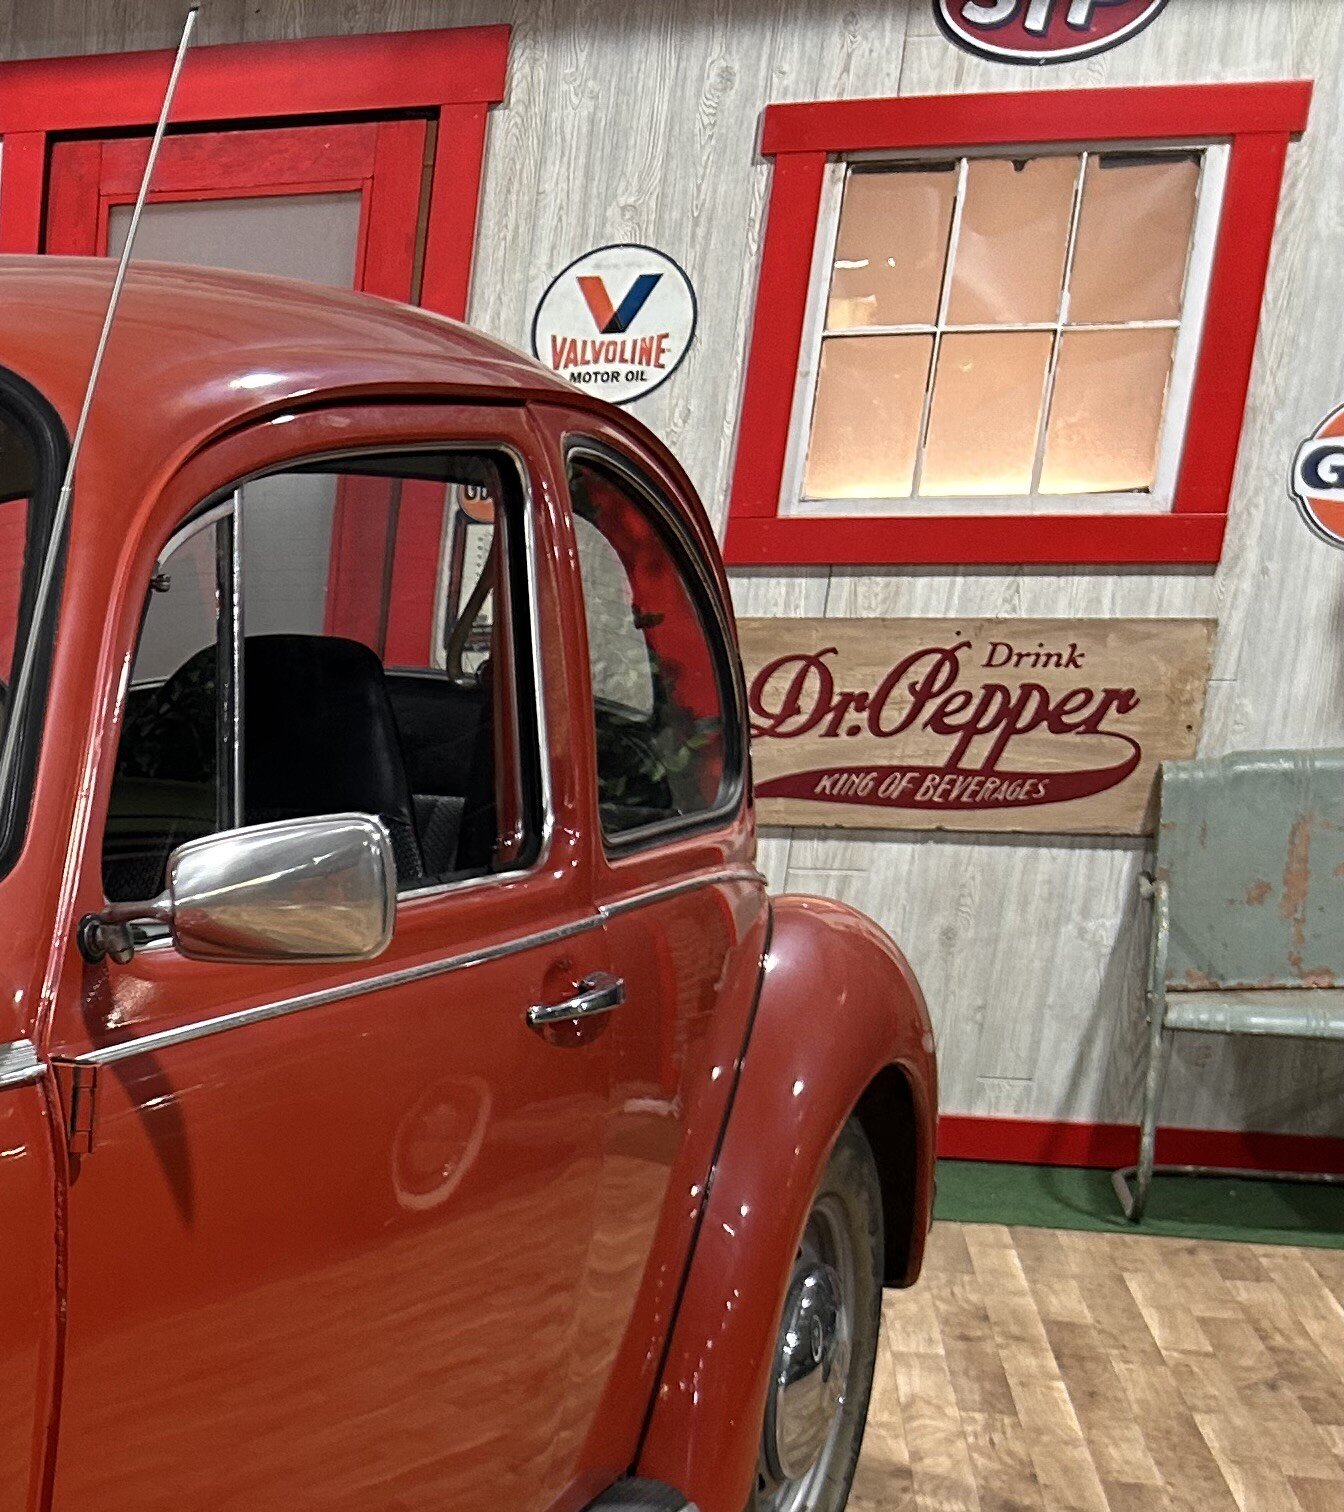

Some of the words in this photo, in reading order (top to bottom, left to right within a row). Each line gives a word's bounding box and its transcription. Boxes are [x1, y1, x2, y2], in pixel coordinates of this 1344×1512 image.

[551, 332, 670, 371] VALVOLINE
[569, 371, 620, 384] MOTOR
[625, 370, 648, 382] OIL
[981, 642, 1086, 669] Drink
[814, 772, 878, 797] KING
[878, 772, 921, 799] OF
[914, 773, 1051, 803] BEVERAGES
